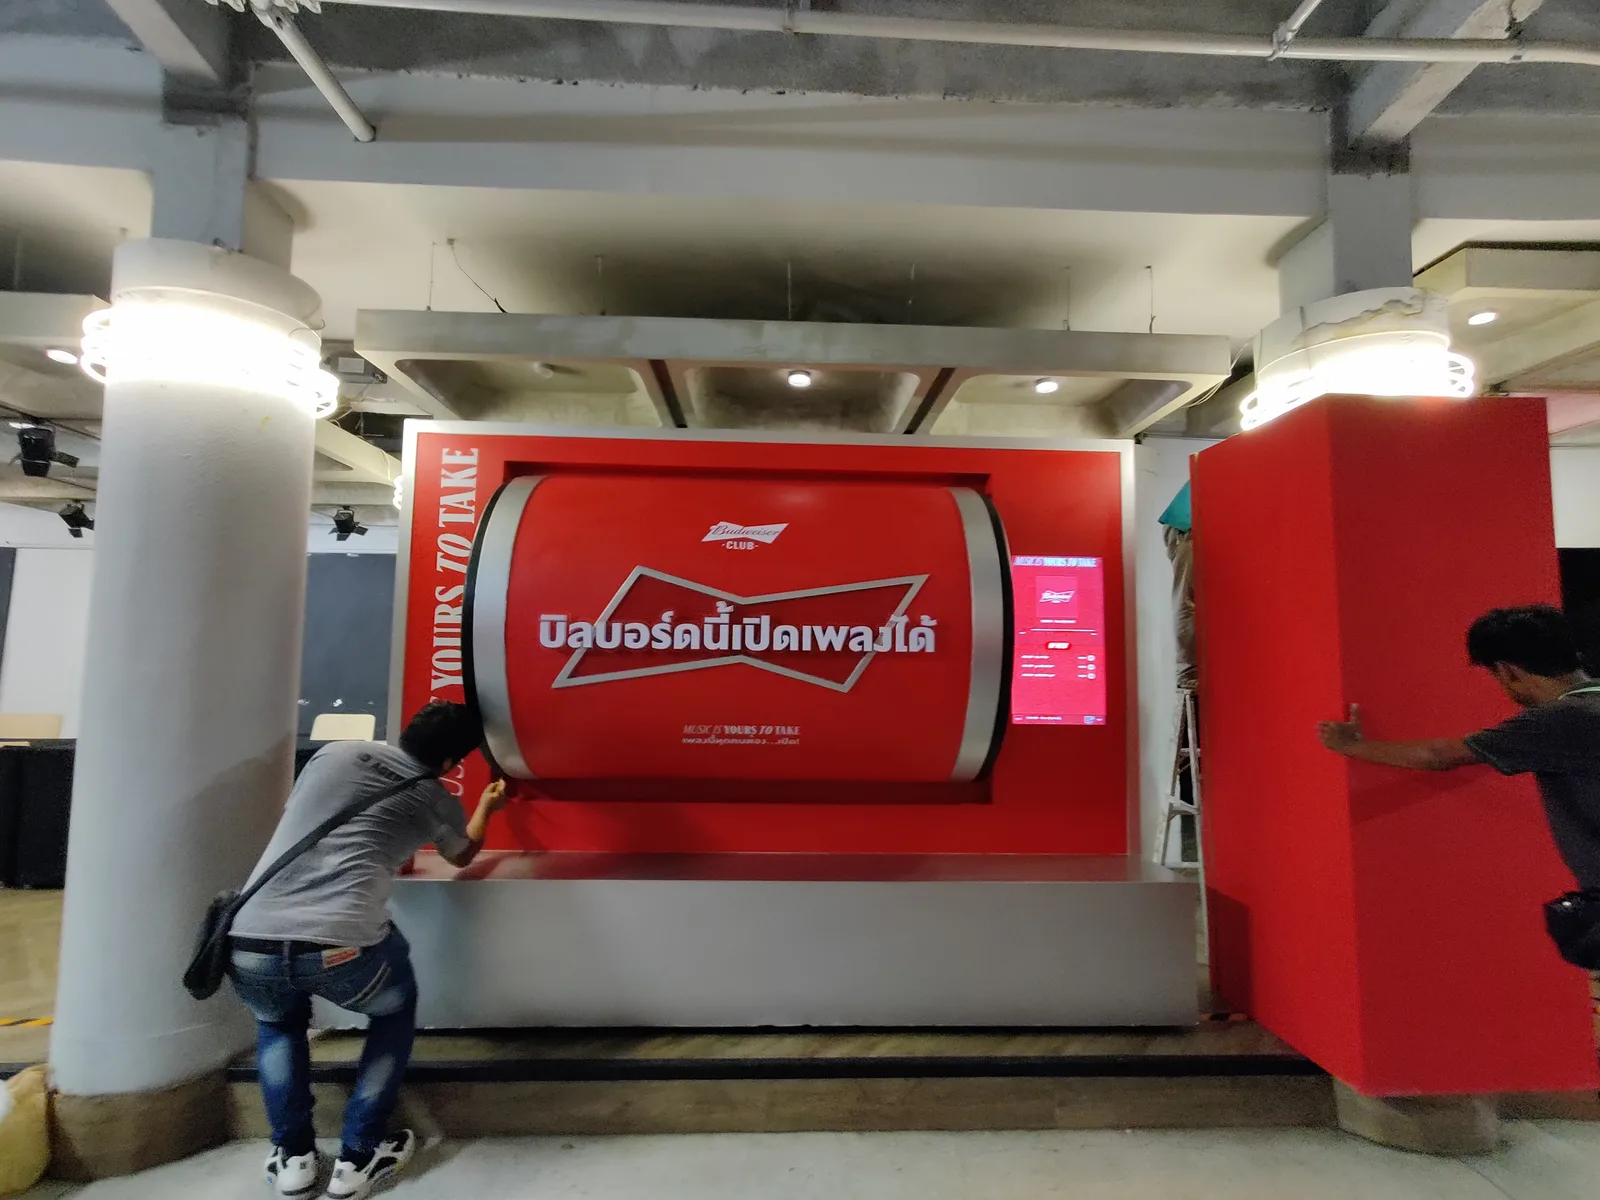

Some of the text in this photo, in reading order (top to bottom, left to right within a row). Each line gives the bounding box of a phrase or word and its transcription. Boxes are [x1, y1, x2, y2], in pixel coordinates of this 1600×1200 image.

[438, 447, 479, 528] TAKE
[436, 533, 473, 573] TO
[726, 540, 755, 550] CLUB
[431, 586, 466, 691] YOURS
[539, 601, 938, 653] บิลบอร์ดนี้เปิดเพลงได้
[683, 724, 712, 735] MUSIC
[724, 725, 757, 735] YOURS
[759, 725, 773, 735] TO
[775, 725, 801, 736] TAKE
